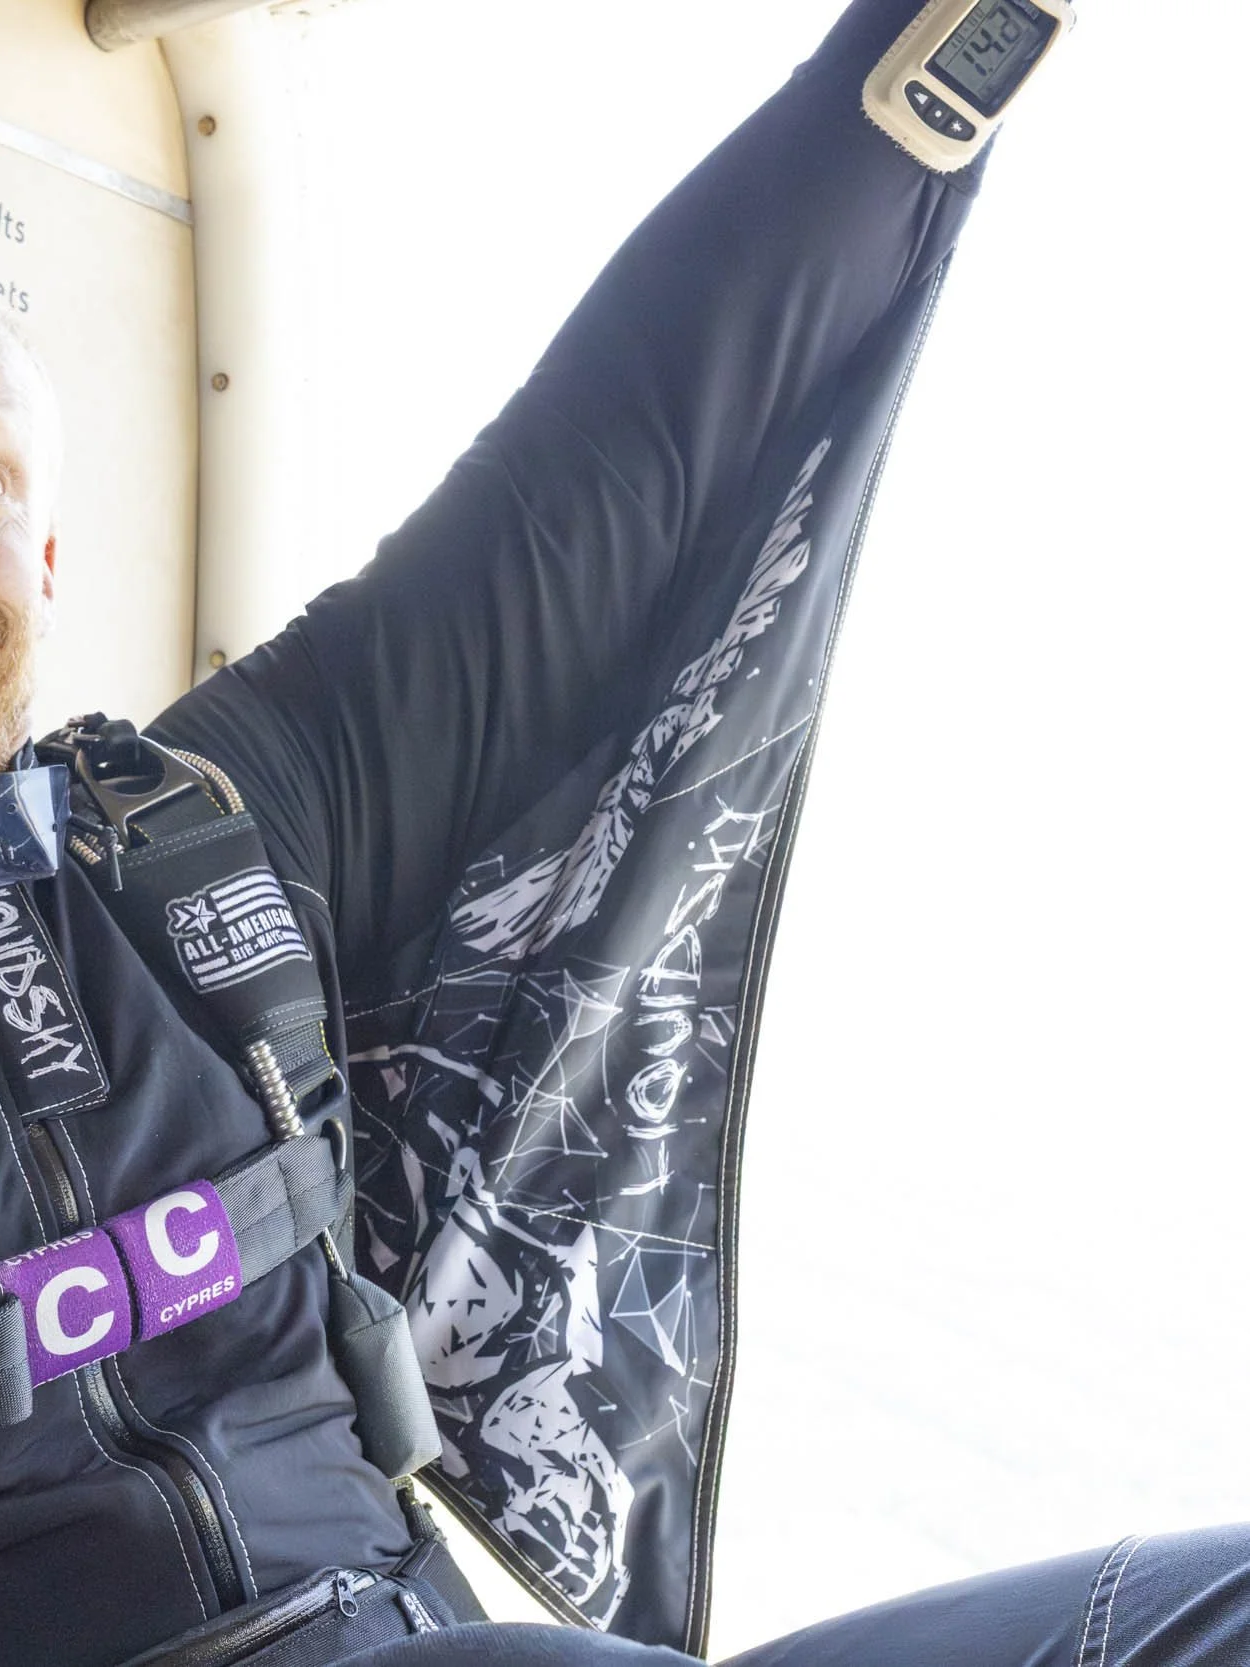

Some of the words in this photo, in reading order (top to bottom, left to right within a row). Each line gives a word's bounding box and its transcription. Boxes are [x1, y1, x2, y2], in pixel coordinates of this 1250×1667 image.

[145, 1190, 219, 1277] C
[35, 1266, 115, 1356] C
[160, 1275, 235, 1323] CYPRES
